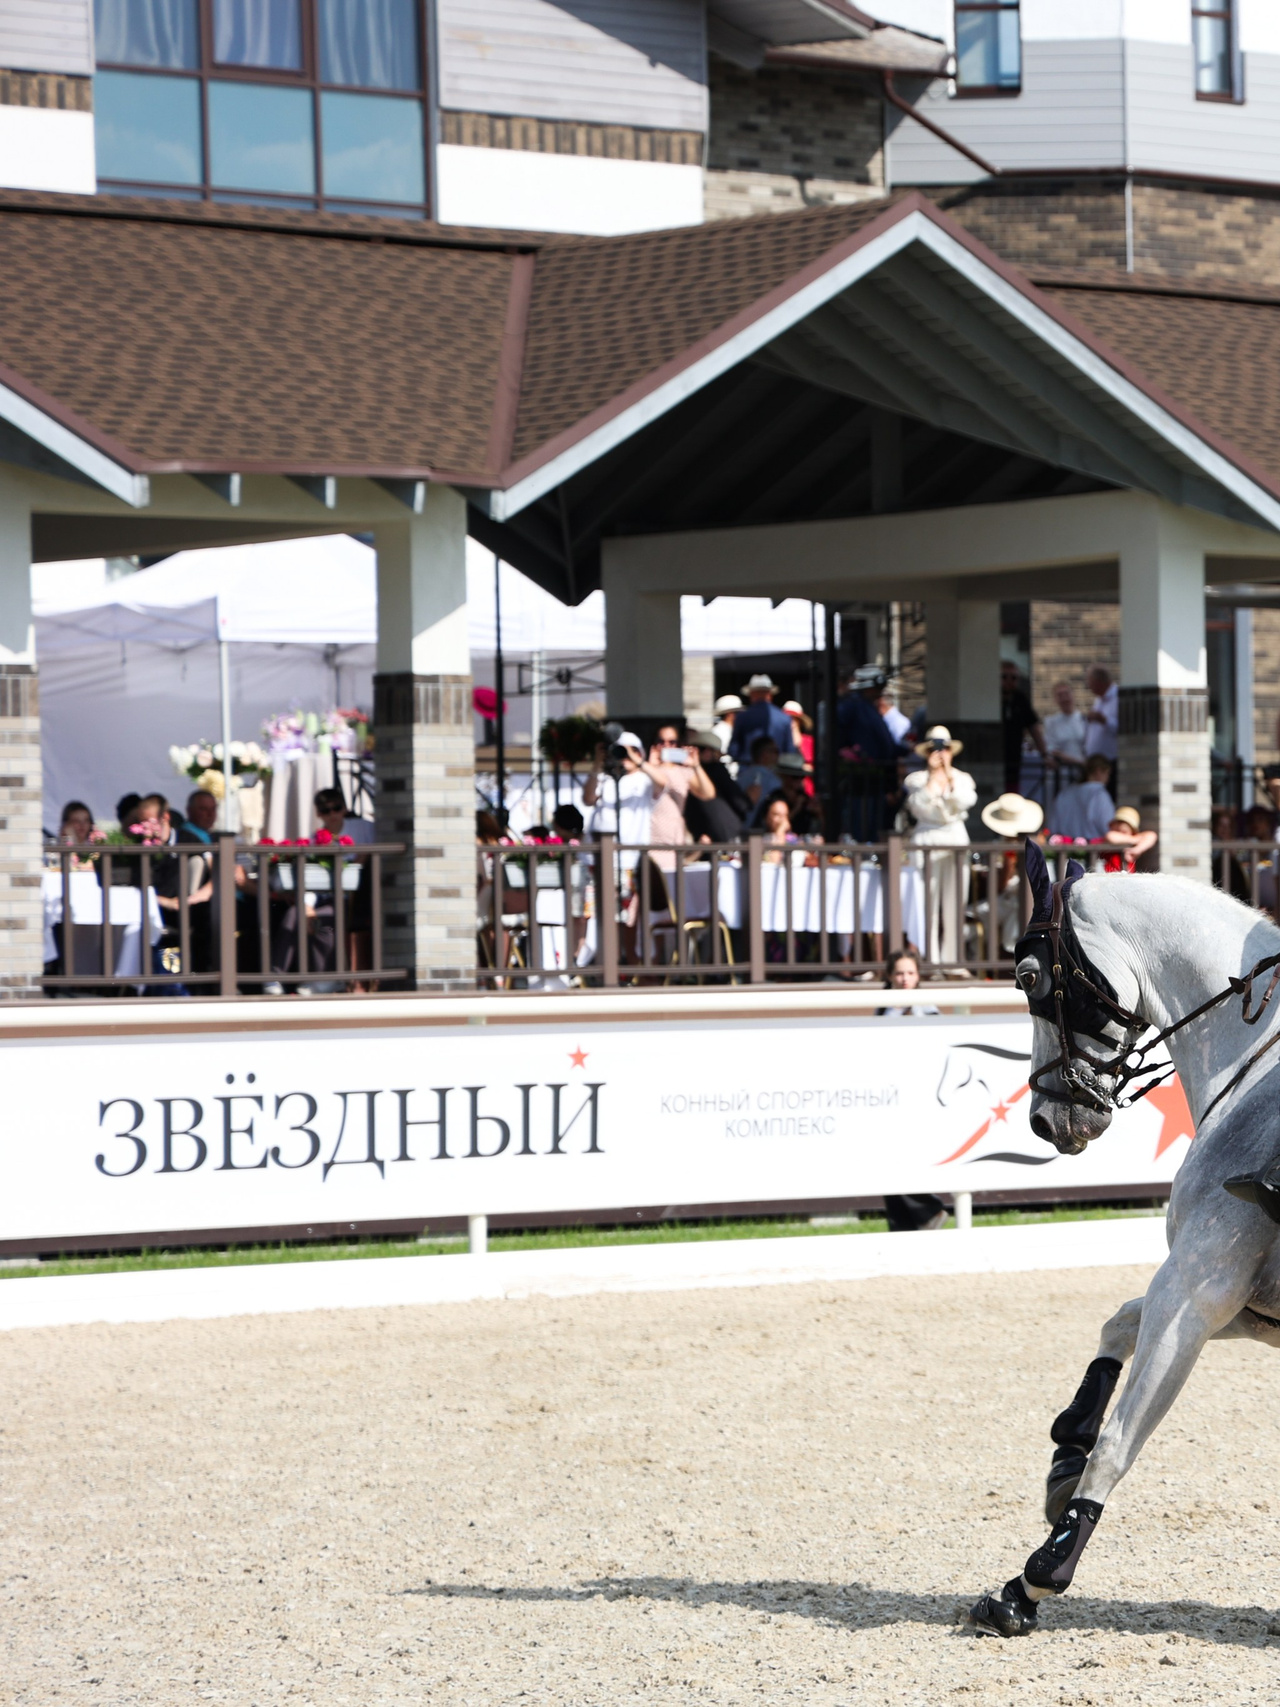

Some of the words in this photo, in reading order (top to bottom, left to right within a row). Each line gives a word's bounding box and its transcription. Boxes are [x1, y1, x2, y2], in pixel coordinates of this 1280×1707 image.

[660, 1088, 750, 1114] КОННЫЙ
[756, 1083, 900, 1111] СПОРТИВНЫЙ
[94, 1046, 607, 1183] ЗВЁЗДНЫЙ
[724, 1115, 836, 1139] КОМПЛЕКС
